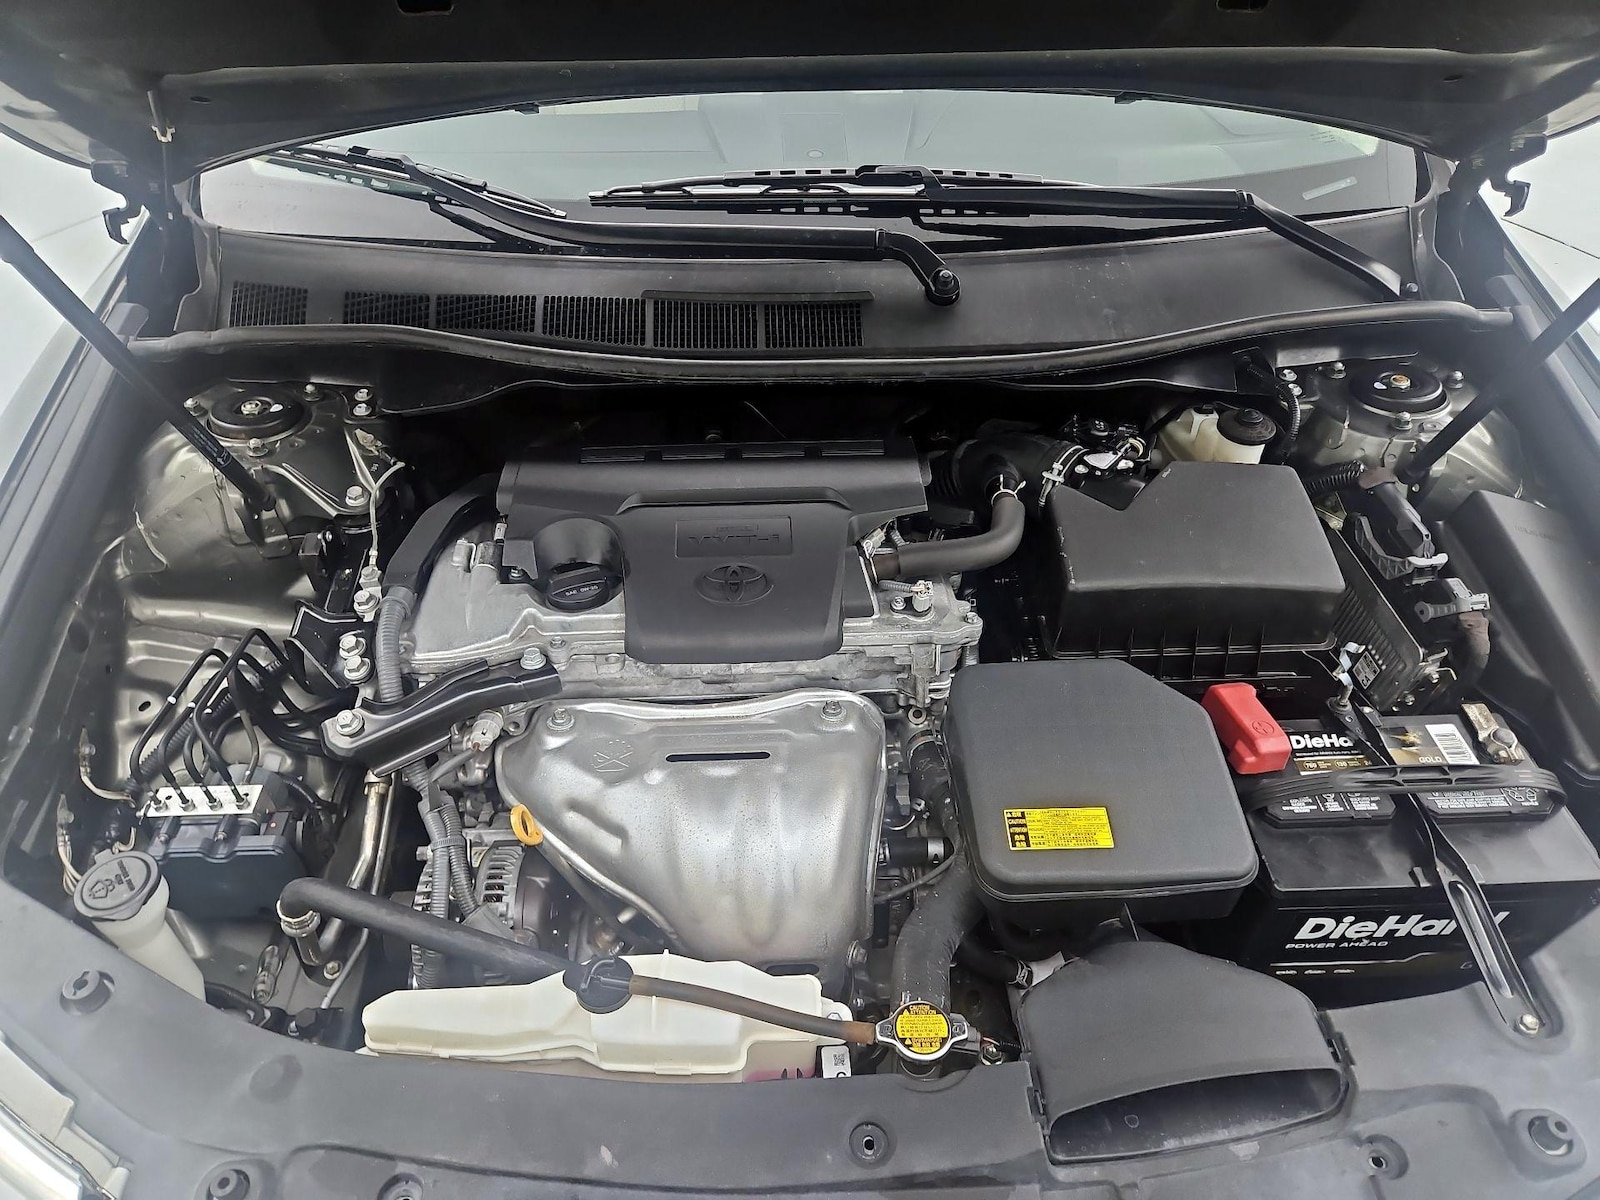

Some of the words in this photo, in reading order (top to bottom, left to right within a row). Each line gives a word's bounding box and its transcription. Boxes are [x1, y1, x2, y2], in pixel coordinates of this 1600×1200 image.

[1289, 733, 1354, 750] DieHa
[1418, 756, 1442, 764] GOLD
[1339, 940, 1389, 948] AHEAD
